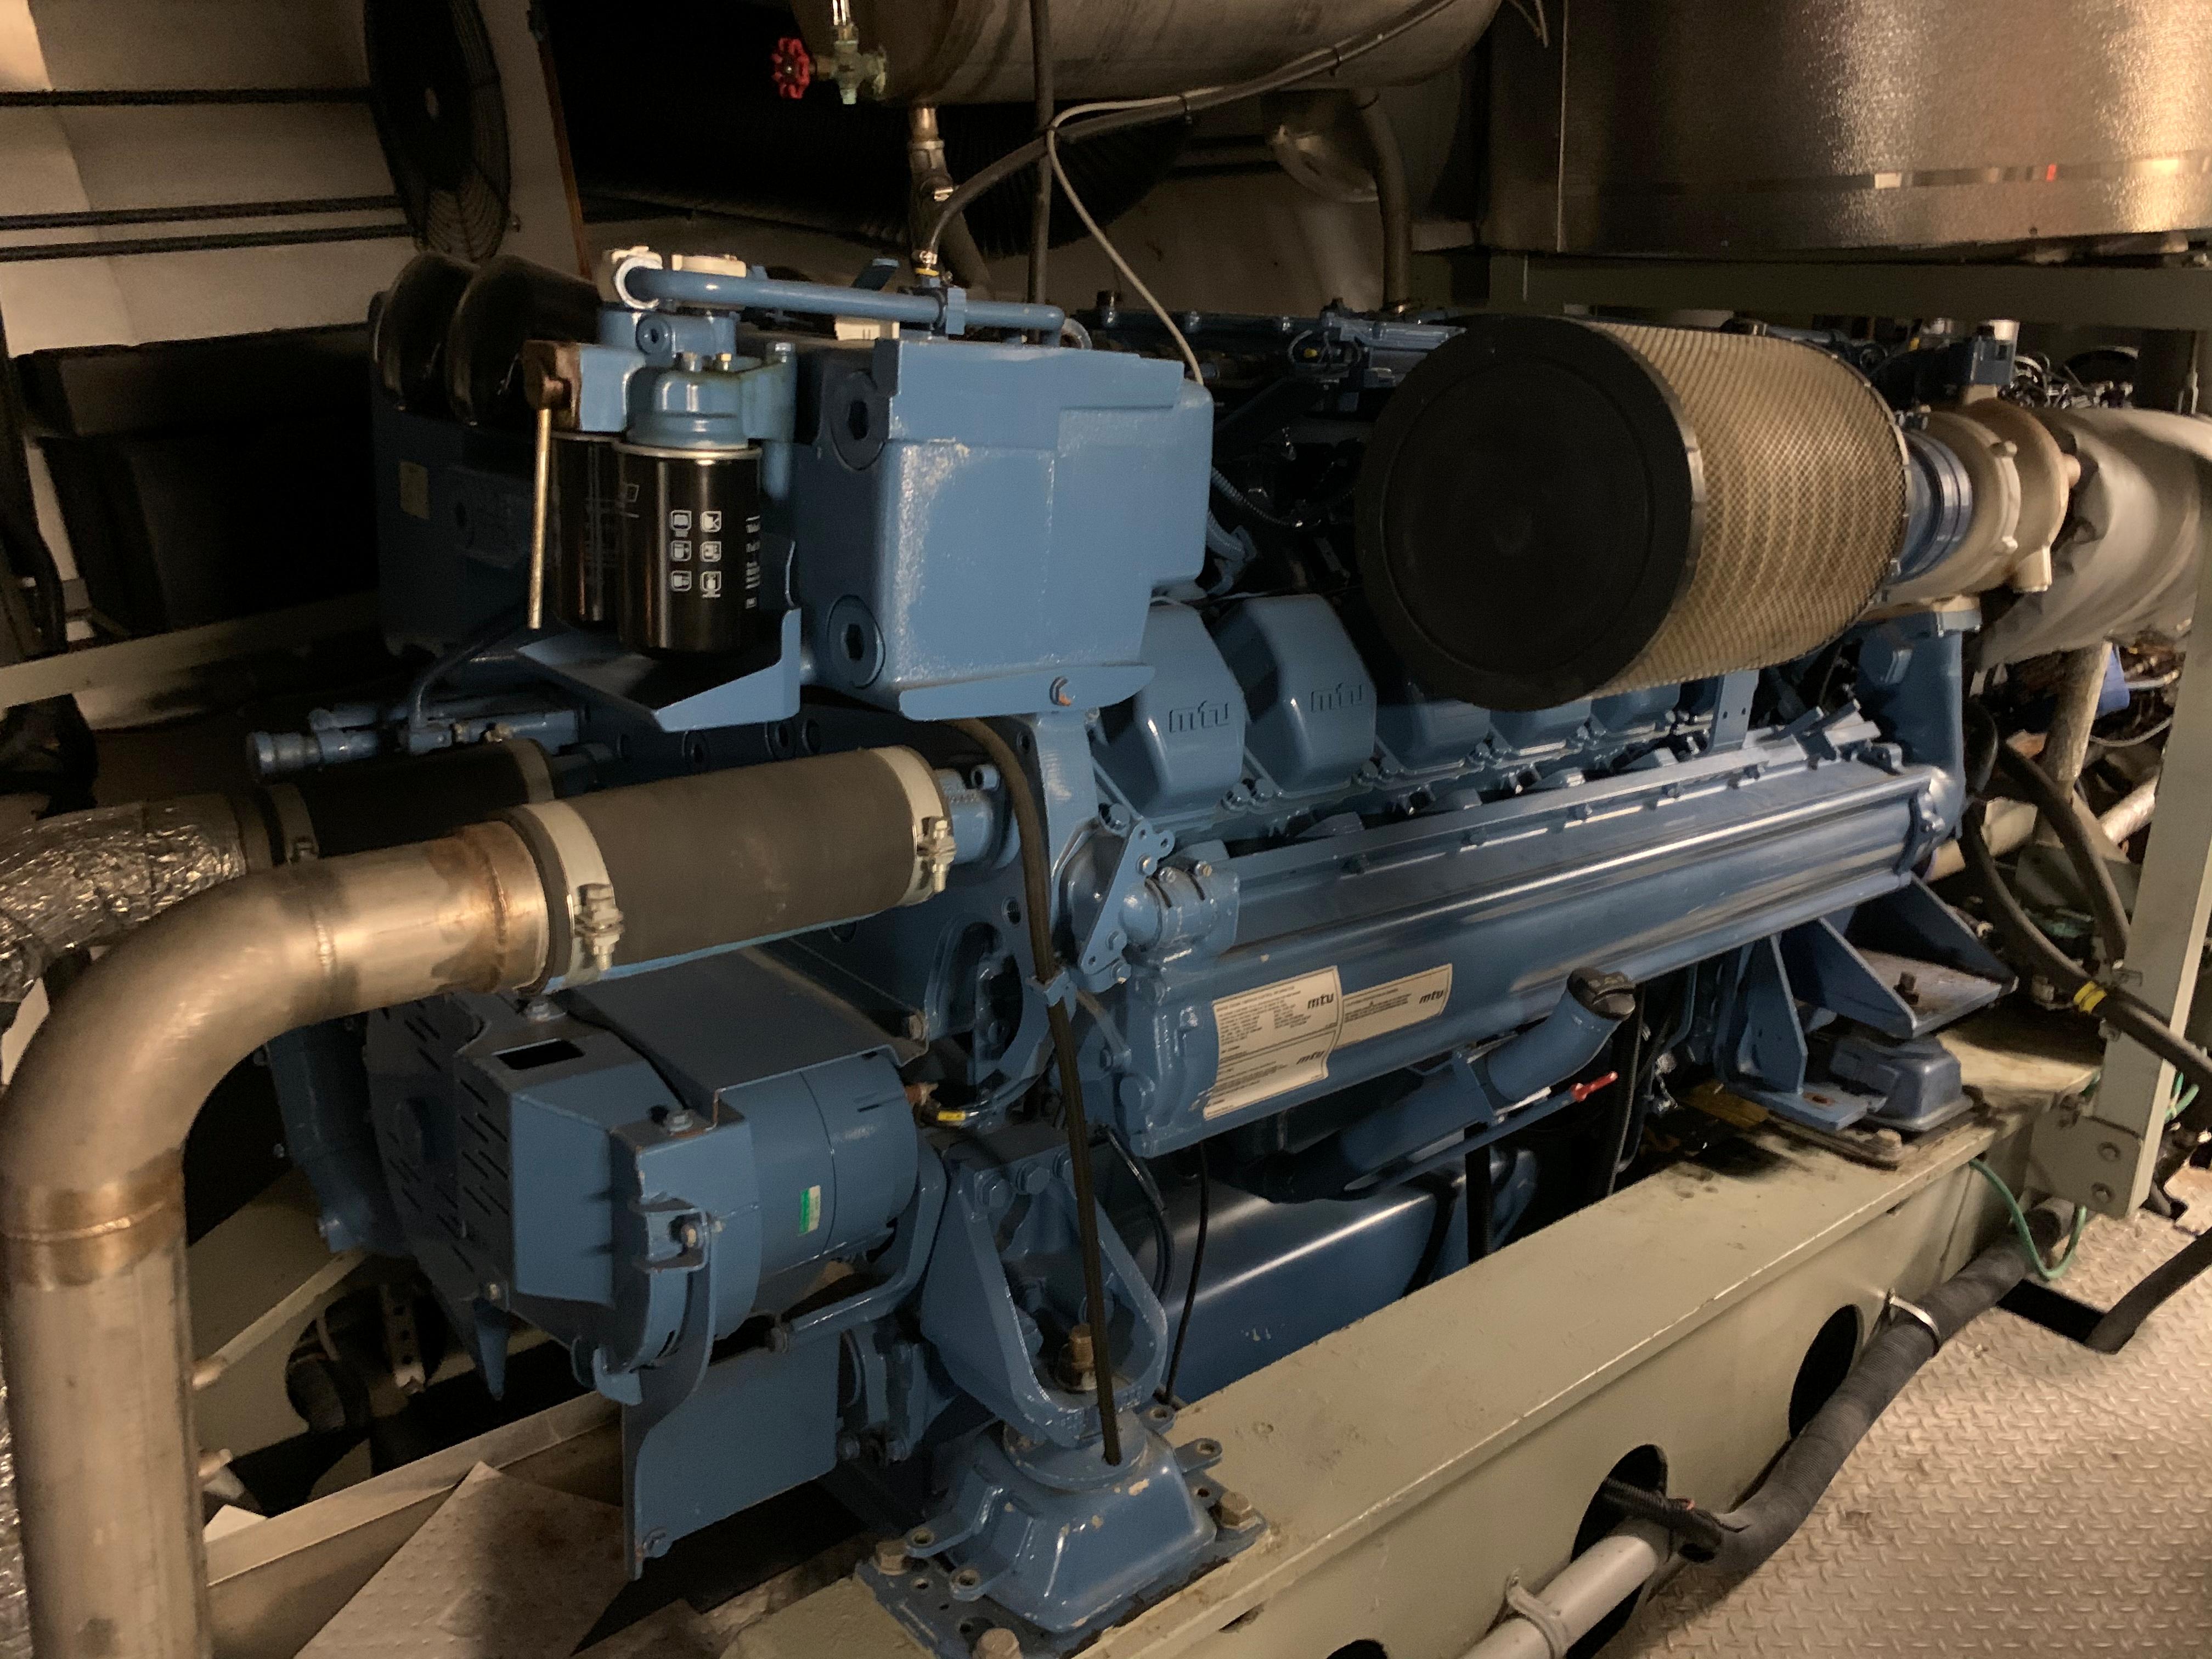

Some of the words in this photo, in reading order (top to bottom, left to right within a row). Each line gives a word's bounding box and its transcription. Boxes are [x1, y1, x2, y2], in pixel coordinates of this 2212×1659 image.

[1311, 682, 1362, 712] mtu
[1169, 700, 1229, 733] mtu
[1307, 992, 1335, 1009] mtu
[1418, 990, 1444, 1005] mtu
[1296, 1050, 1325, 1065] mtu
